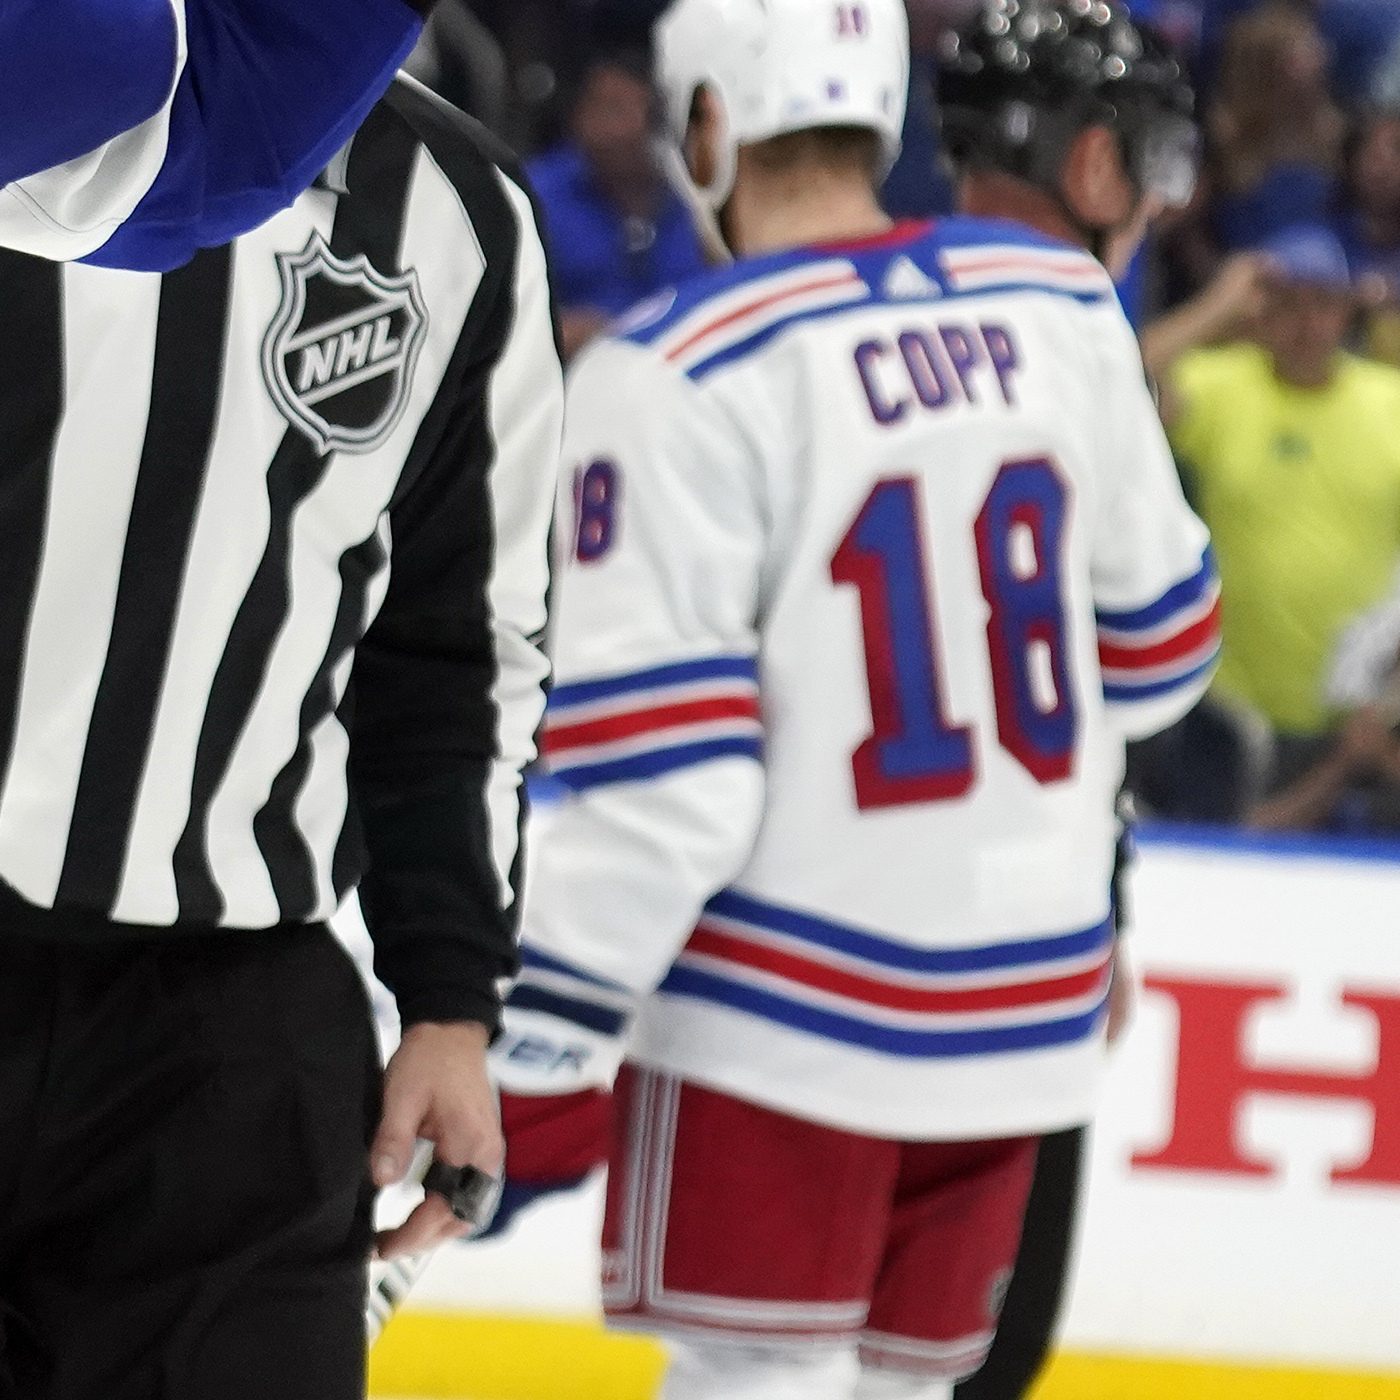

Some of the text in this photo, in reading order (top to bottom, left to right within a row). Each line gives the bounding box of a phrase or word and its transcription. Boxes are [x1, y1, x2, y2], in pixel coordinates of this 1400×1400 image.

[296, 314, 402, 393] NHL
[853, 322, 1023, 428] COPP
[830, 456, 1082, 813] 18
